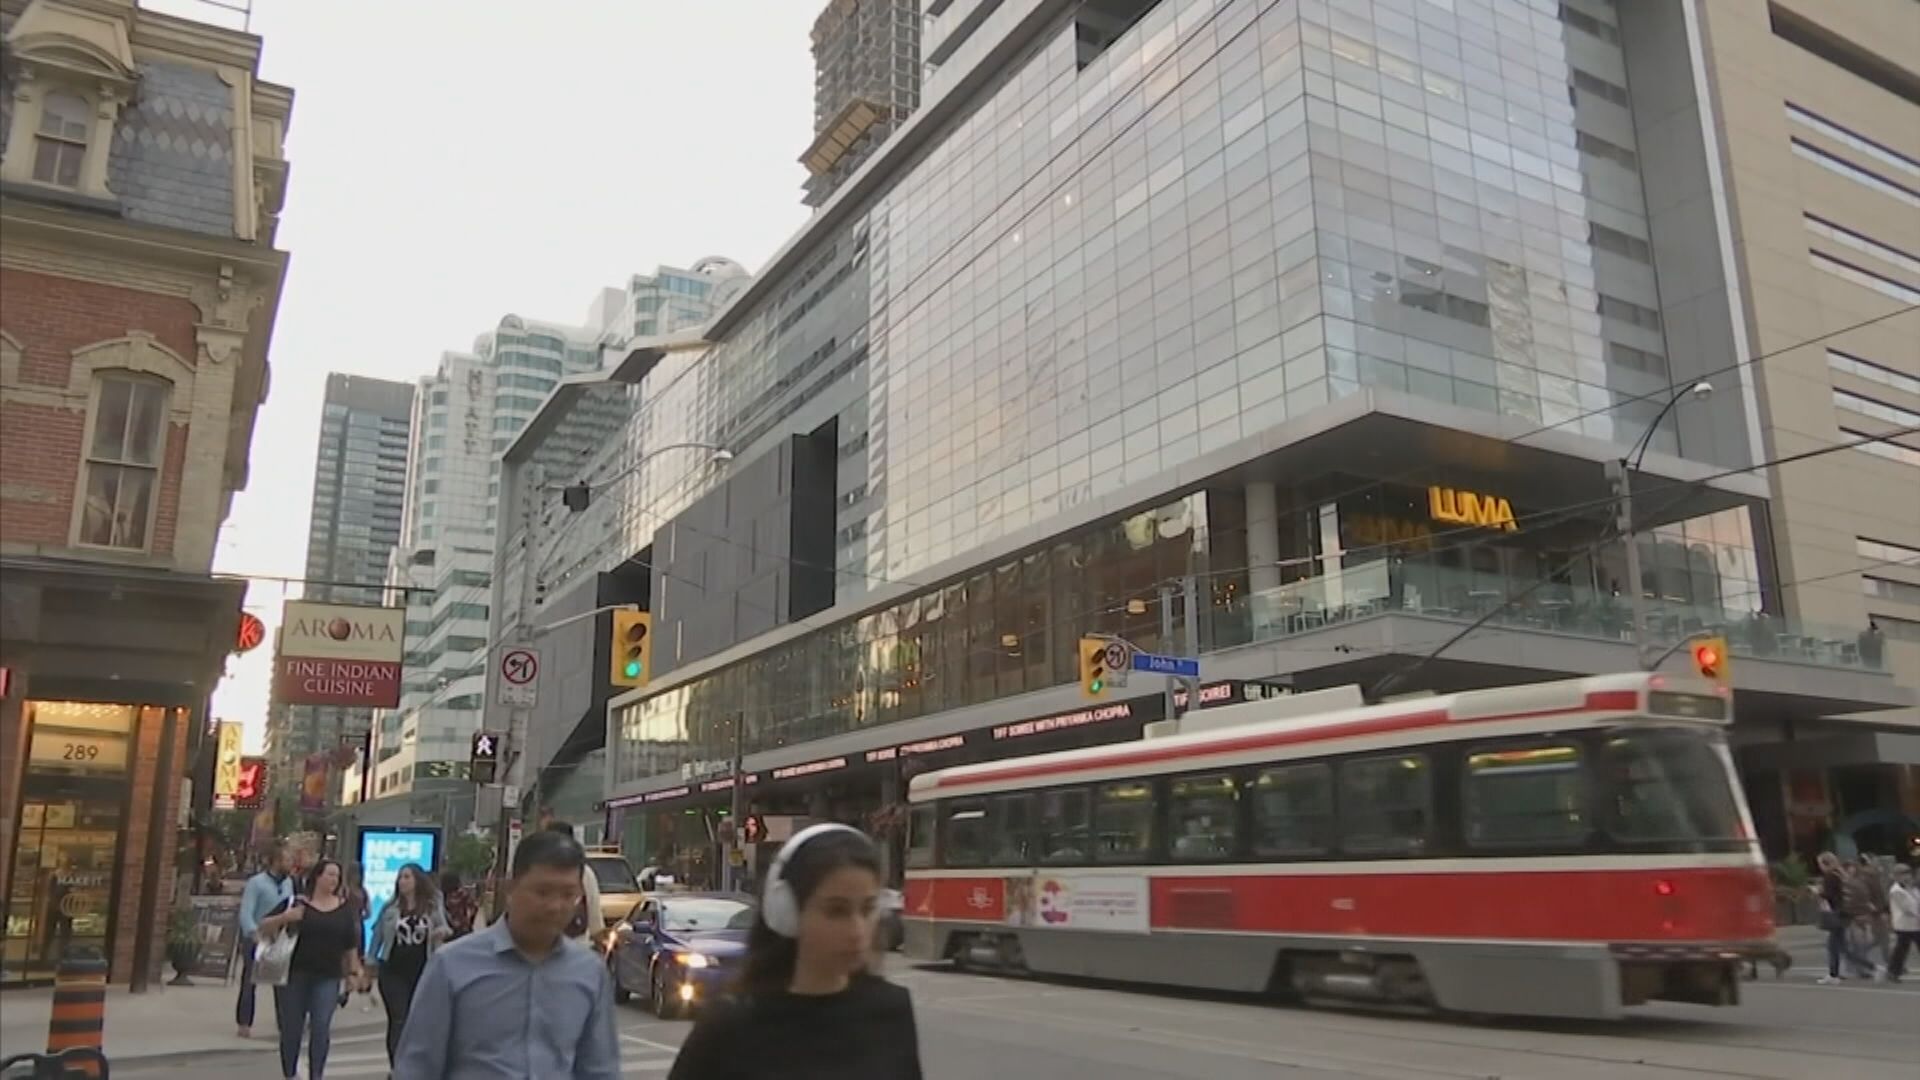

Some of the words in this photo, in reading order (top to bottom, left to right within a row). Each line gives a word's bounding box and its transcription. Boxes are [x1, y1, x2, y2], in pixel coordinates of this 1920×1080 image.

[1429, 486, 1519, 531] LUMA
[291, 618, 395, 642] AROMA
[287, 661, 325, 677] FINE
[331, 663, 394, 680] INDIAN
[1150, 656, 1175, 670] John
[303, 679, 374, 696] CUISINE
[63, 744, 98, 760] 289
[221, 725, 239, 793] AROMA
[367, 839, 422, 859] NICE
